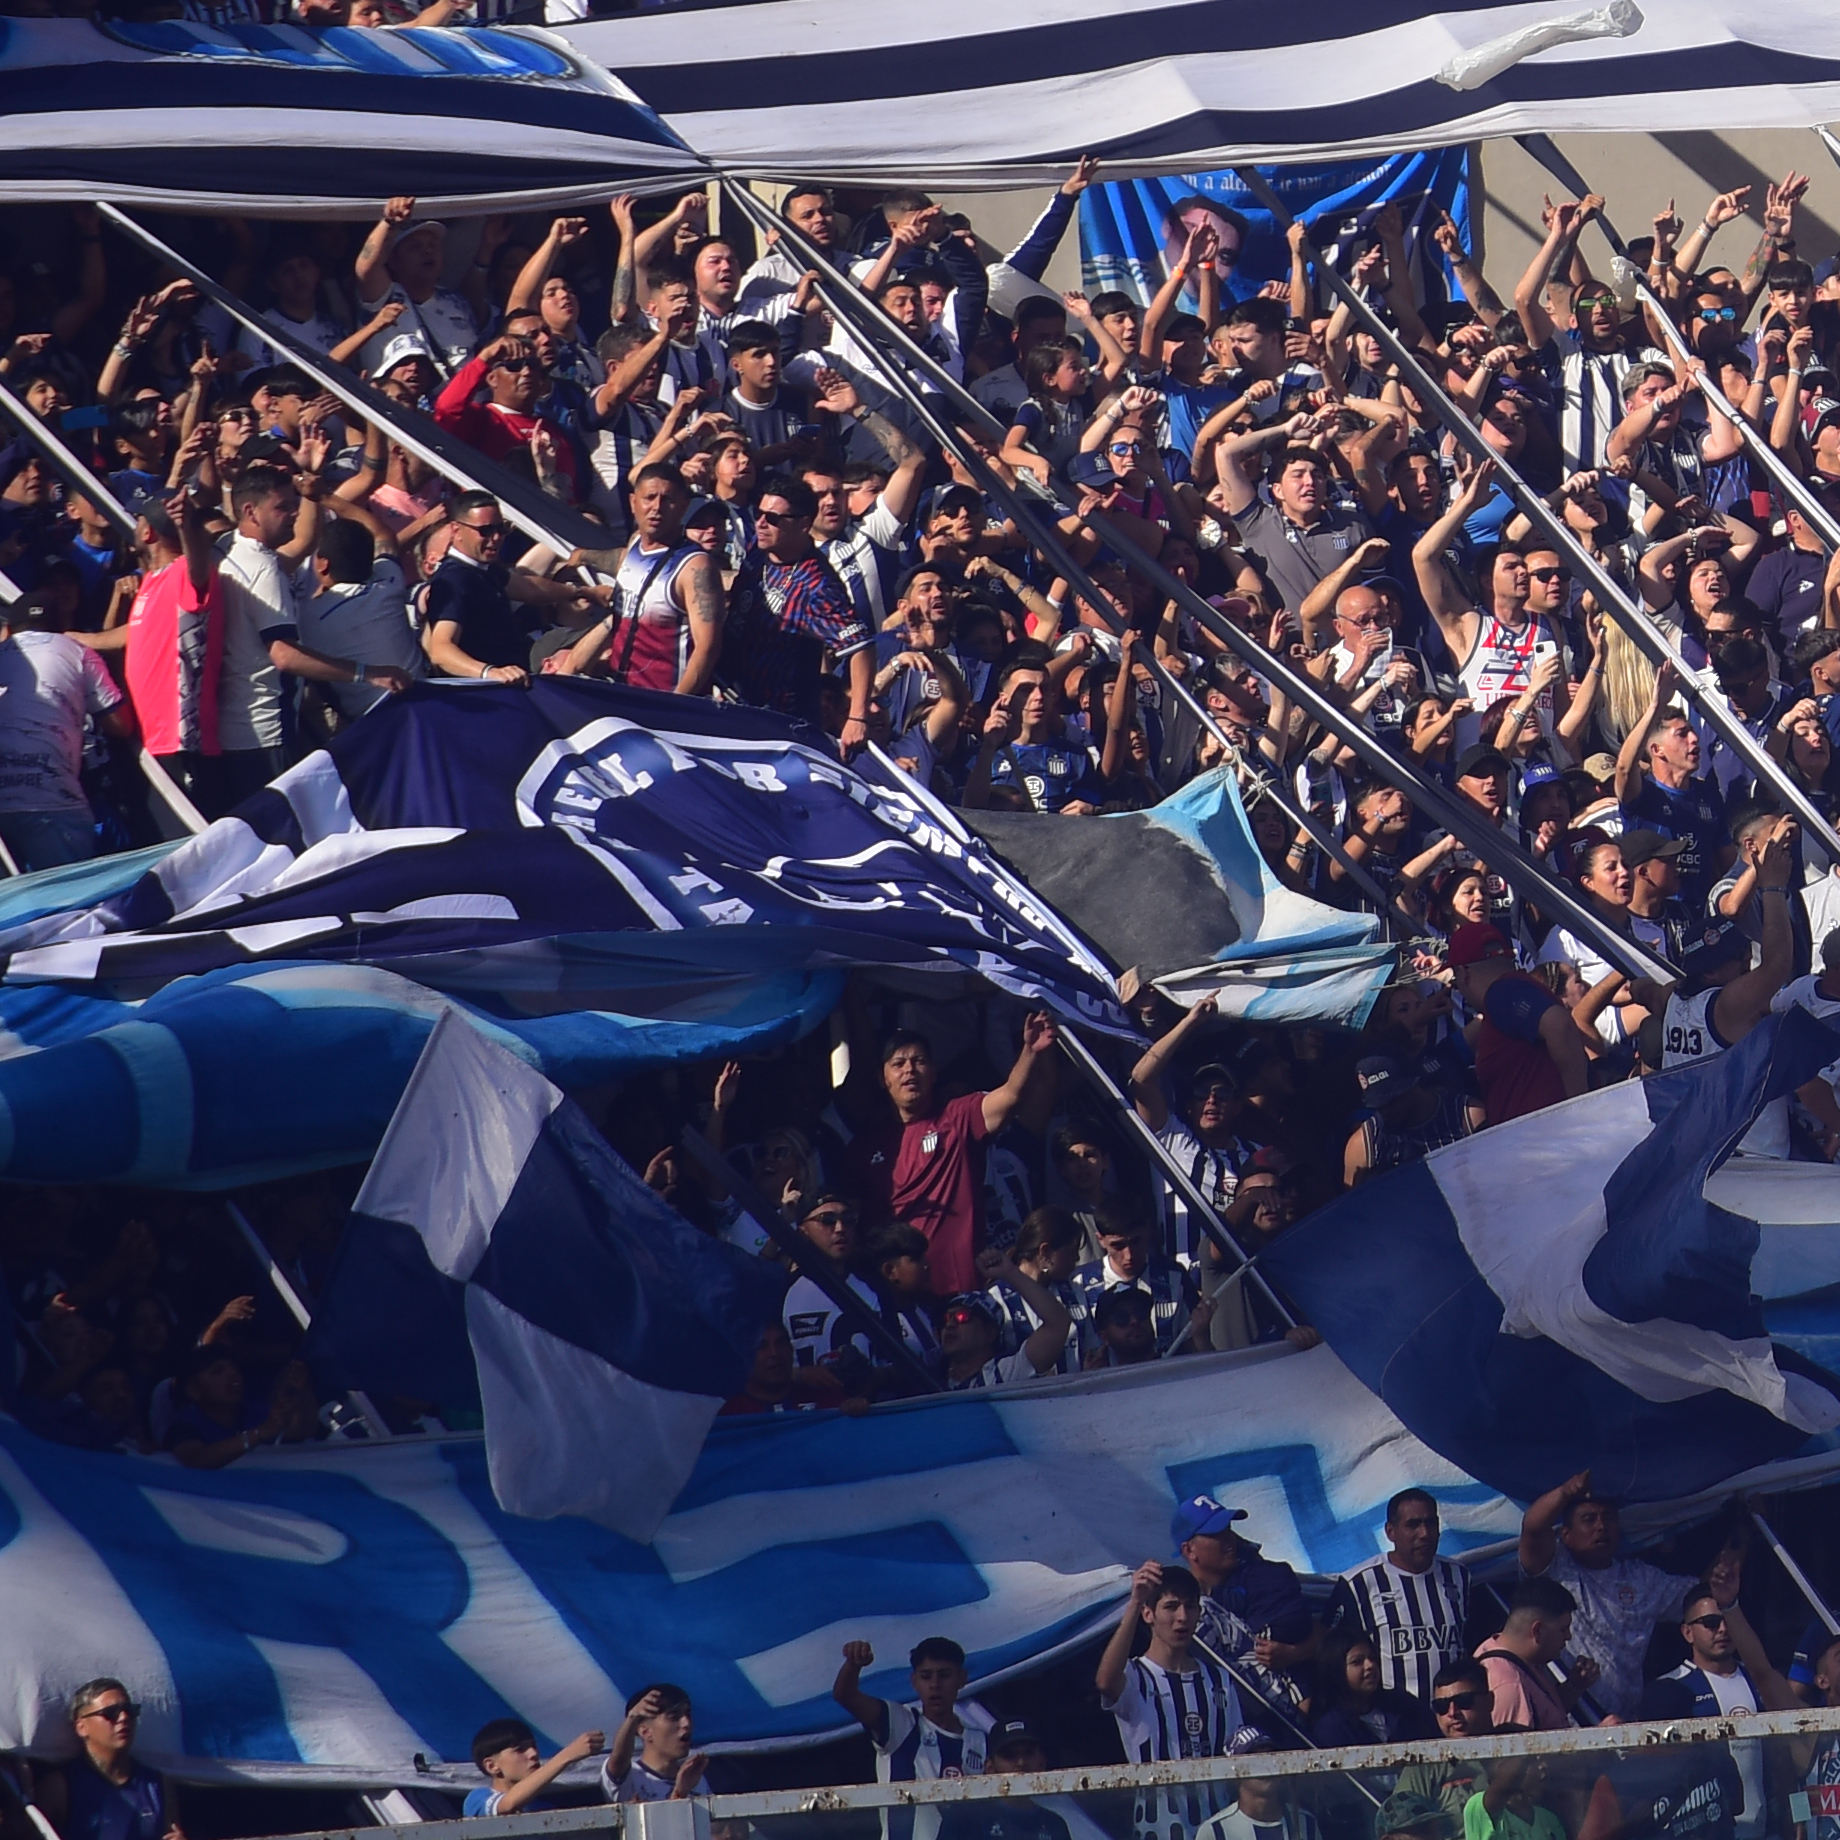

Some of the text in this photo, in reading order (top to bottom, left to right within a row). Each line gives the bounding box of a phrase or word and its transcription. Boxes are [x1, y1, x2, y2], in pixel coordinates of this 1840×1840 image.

[1676, 853, 1700, 864] ICBC
[1664, 1027, 1701, 1055] 1913
[1391, 1626, 1461, 1654] BBVA
